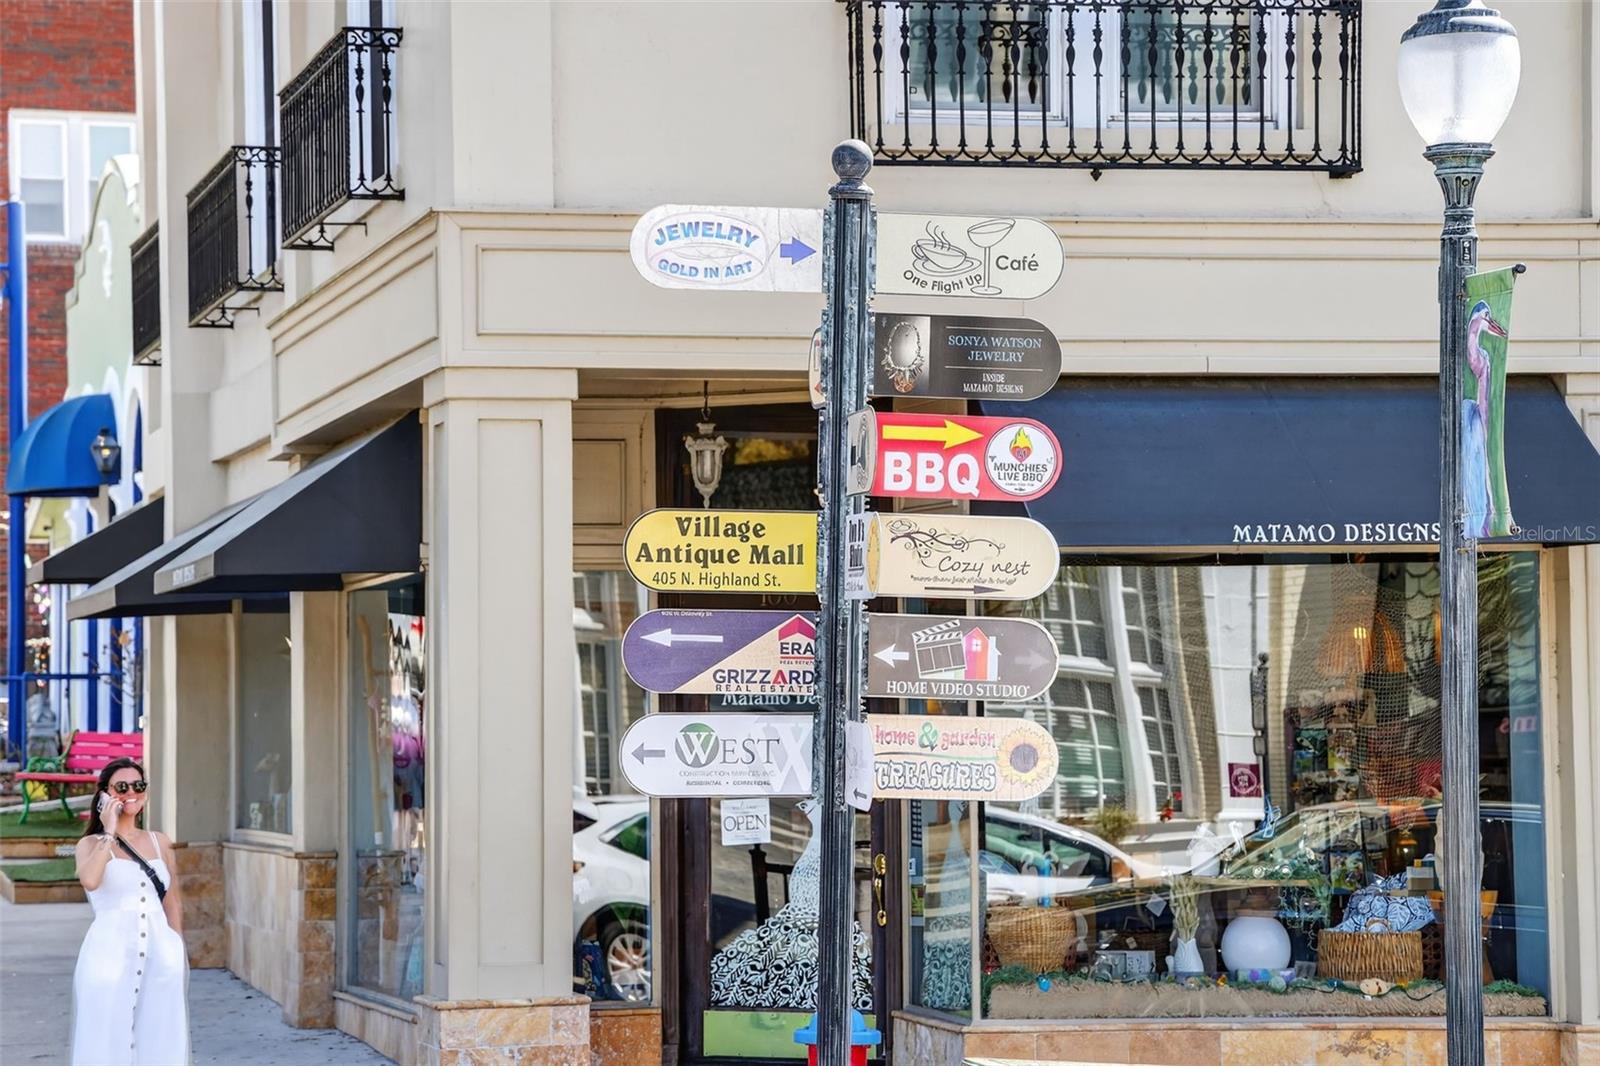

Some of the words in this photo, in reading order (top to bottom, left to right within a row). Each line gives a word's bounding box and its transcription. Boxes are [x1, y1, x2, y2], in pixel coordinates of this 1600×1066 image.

[655, 221, 760, 248] JEWELRY
[658, 259, 699, 278] GOLD
[704, 267, 719, 278] IN
[725, 261, 752, 278] ART
[995, 253, 1039, 271] Café
[903, 270, 928, 288] One
[931, 278, 964, 294] Flight
[965, 273, 983, 287] Up
[948, 335, 988, 347] SONYA
[991, 337, 1042, 349] WATSON
[968, 351, 1025, 363] JEWELRY
[883, 451, 980, 497] BBQ
[994, 462, 1048, 473] MUNCHIES
[998, 472, 1020, 481] LIVE
[1022, 472, 1044, 483] BBQ
[675, 516, 766, 543] Village
[1232, 523, 1335, 543] MATAMO
[1344, 522, 1441, 543] DESIGNS
[635, 543, 740, 569] Antique
[748, 544, 804, 565] Mall
[939, 555, 985, 575] Cozy
[992, 559, 1031, 576] nest
[652, 572, 676, 585] 405
[681, 572, 695, 586] N.
[699, 572, 760, 589] Highland
[764, 573, 781, 587] St.
[780, 642, 815, 655] ERA
[712, 669, 815, 685] GRIZZARD
[760, 685, 813, 694] ESTATE
[887, 681, 927, 695] HOME
[931, 682, 973, 696] VIDEO
[976, 684, 1027, 698] STUDIO
[875, 725, 915, 745] home
[918, 722, 938, 751] &
[941, 728, 997, 751] garden
[678, 729, 780, 766] WEST
[875, 760, 997, 792] TREASURES
[723, 814, 768, 832] OPEN
